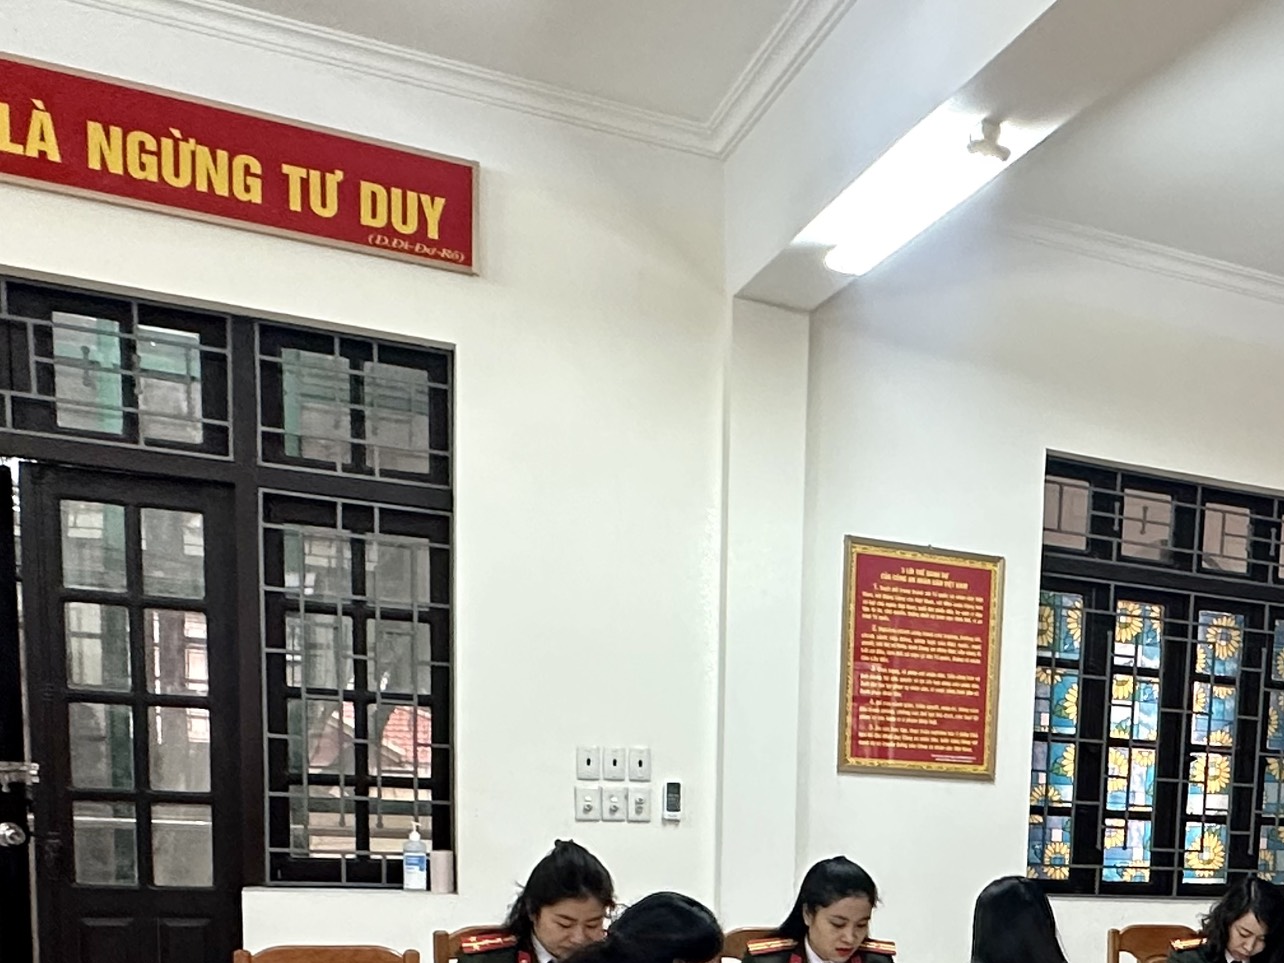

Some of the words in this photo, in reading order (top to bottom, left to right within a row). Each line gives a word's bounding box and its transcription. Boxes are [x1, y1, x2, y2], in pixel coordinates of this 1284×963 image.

[0, 98, 62, 163] LÀ
[86, 120, 262, 204] NGỪNG
[281, 163, 344, 218] TƯ
[359, 180, 446, 240] DUY
